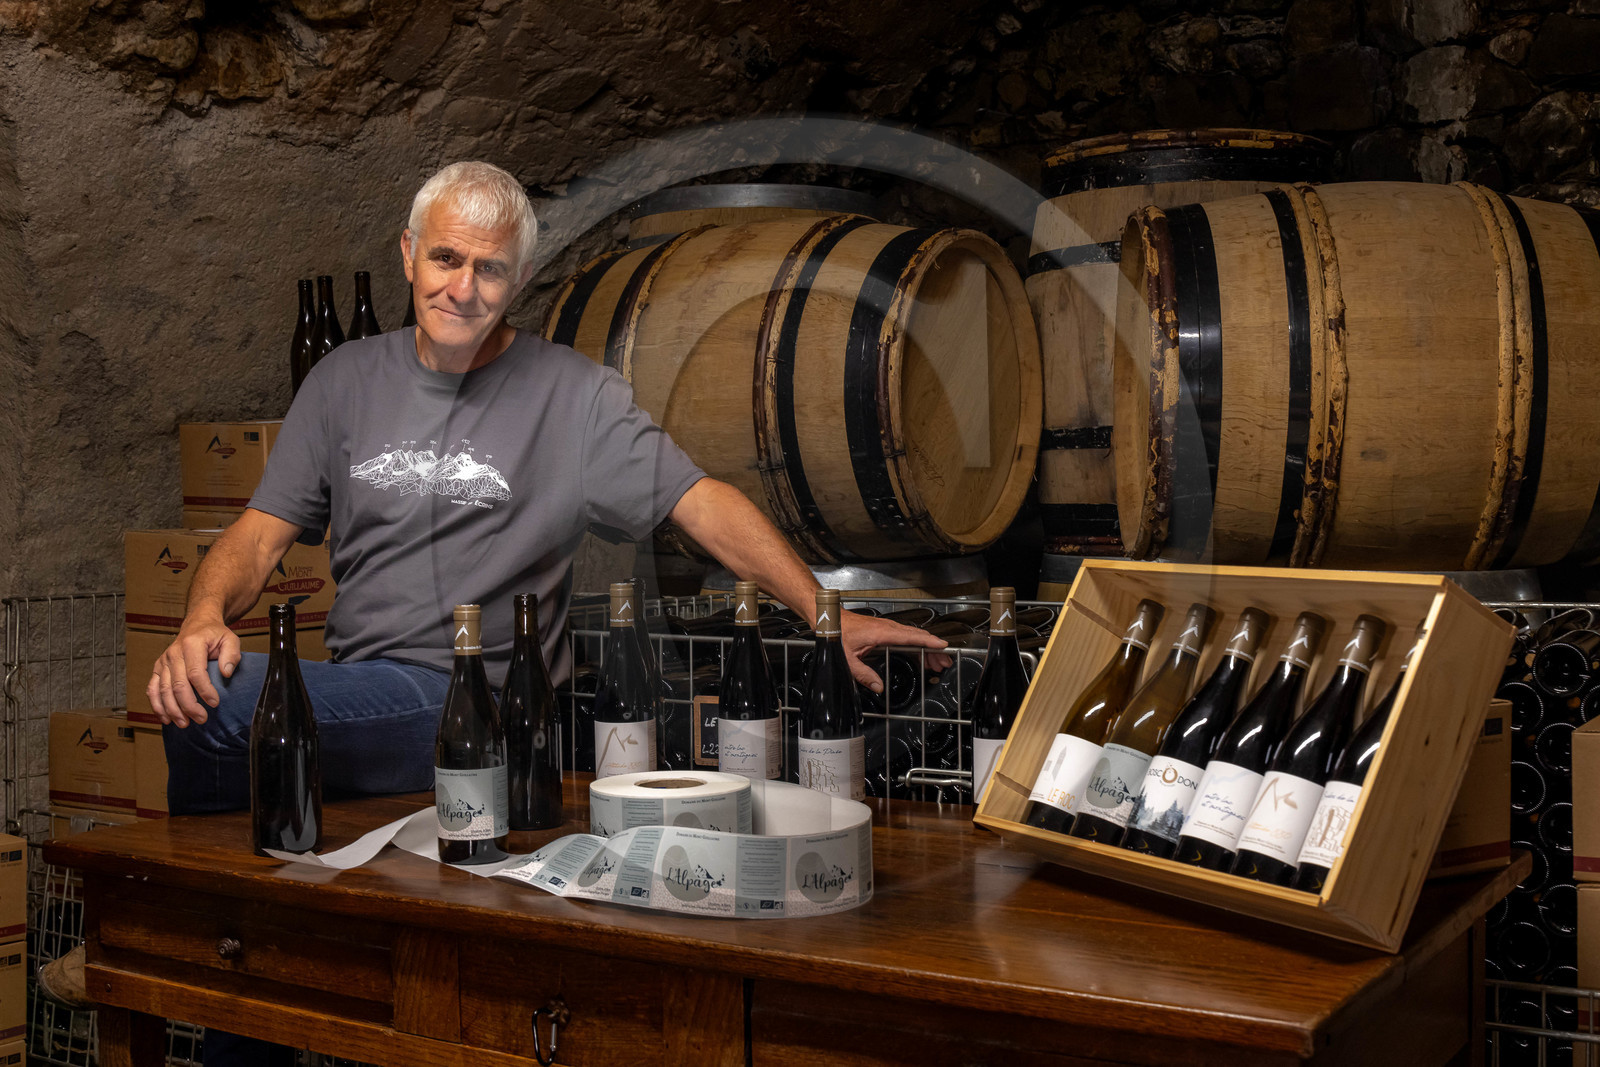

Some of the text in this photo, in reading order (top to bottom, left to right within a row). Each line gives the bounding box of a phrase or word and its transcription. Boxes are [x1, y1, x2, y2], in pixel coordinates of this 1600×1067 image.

[288, 566, 313, 578] MONT
[277, 580, 320, 591] GUILLAUME
[1047, 787, 1075, 810] LE ROC
[665, 866, 716, 894] L'Alpage
[802, 872, 849, 893] L'Alpage
